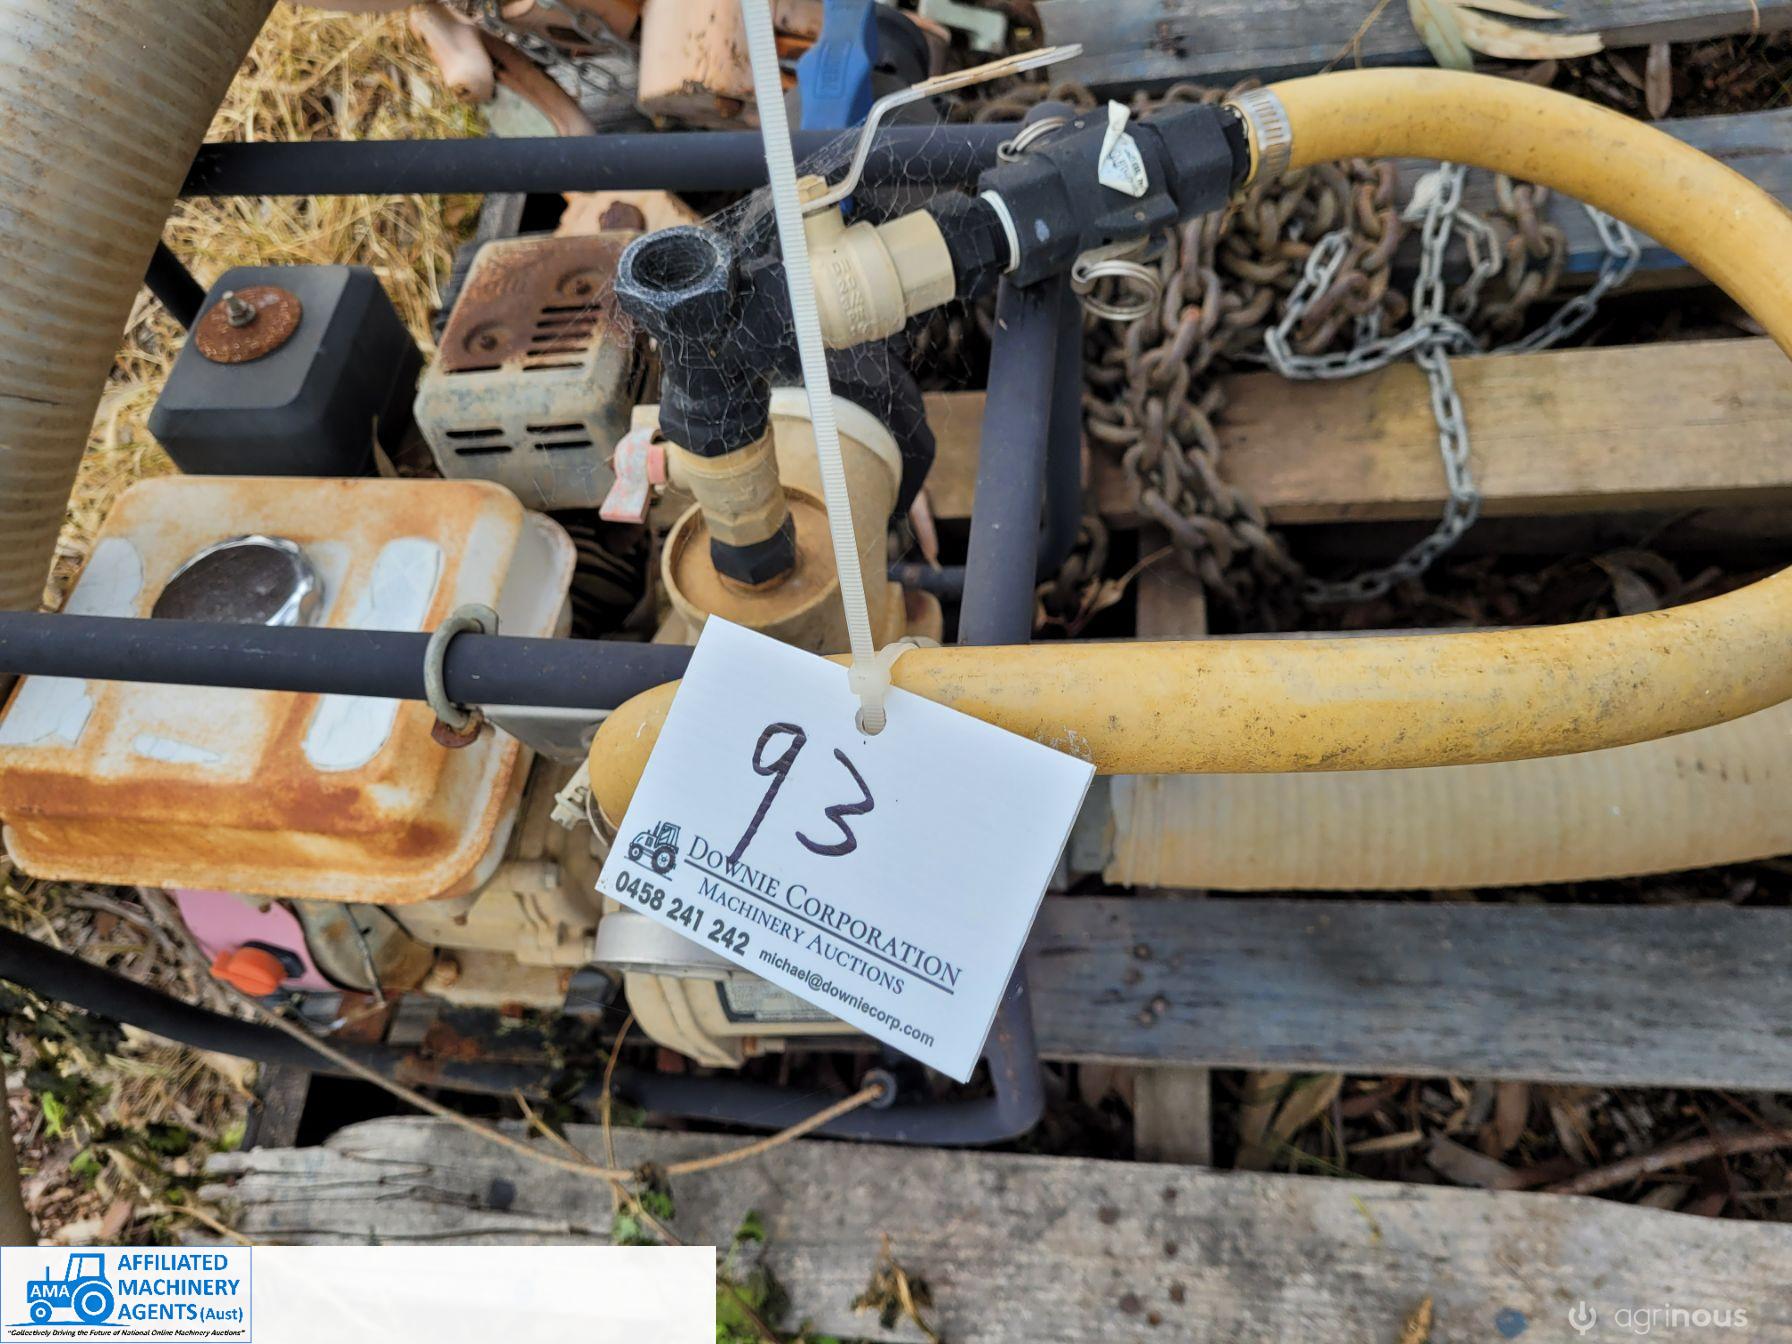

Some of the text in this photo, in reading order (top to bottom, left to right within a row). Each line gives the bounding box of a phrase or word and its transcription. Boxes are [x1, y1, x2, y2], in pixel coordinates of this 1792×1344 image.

[728, 721, 875, 864] 93
[615, 871, 750, 957] 0458 241 242
[687, 835, 962, 986] DOWNIE CORPORATION
[698, 877, 905, 995] MACHINERY AUCTIONS
[759, 950, 935, 1047] michael@downiecorp.com
